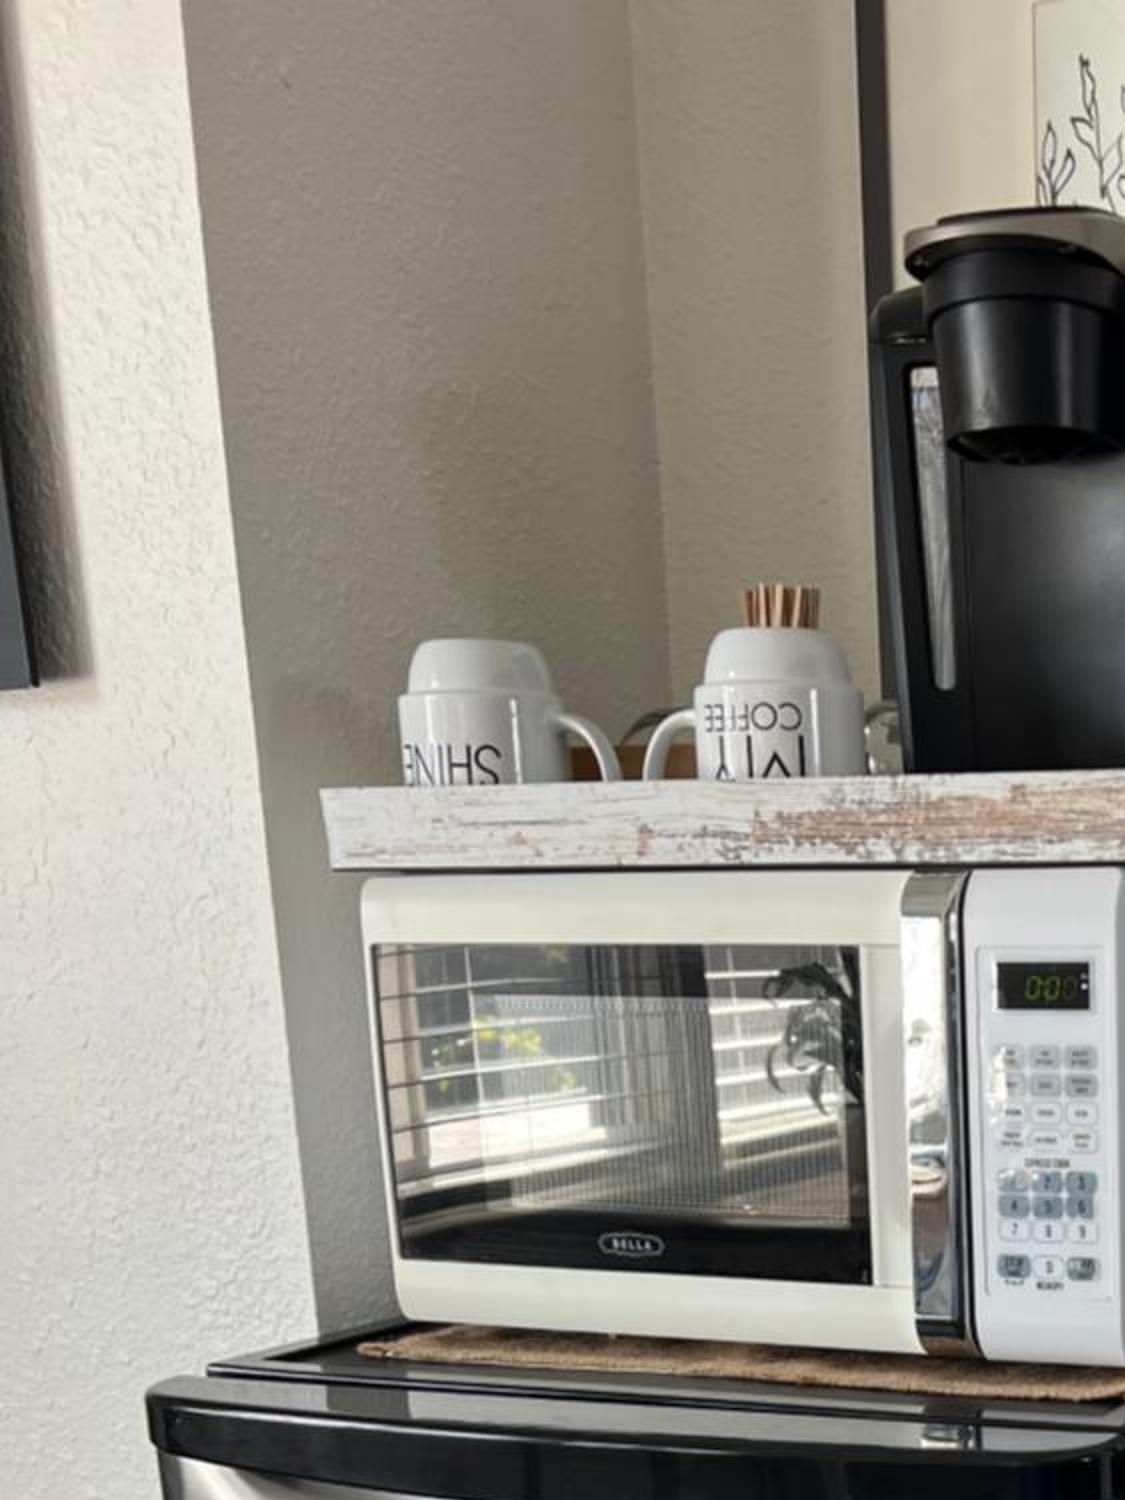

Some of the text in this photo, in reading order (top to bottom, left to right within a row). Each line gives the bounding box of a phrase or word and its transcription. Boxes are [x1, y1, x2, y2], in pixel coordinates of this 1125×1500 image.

[703, 702, 803, 732] COFFEE
[404, 745, 502, 786] SHINE
[715, 735, 807, 781] MY
